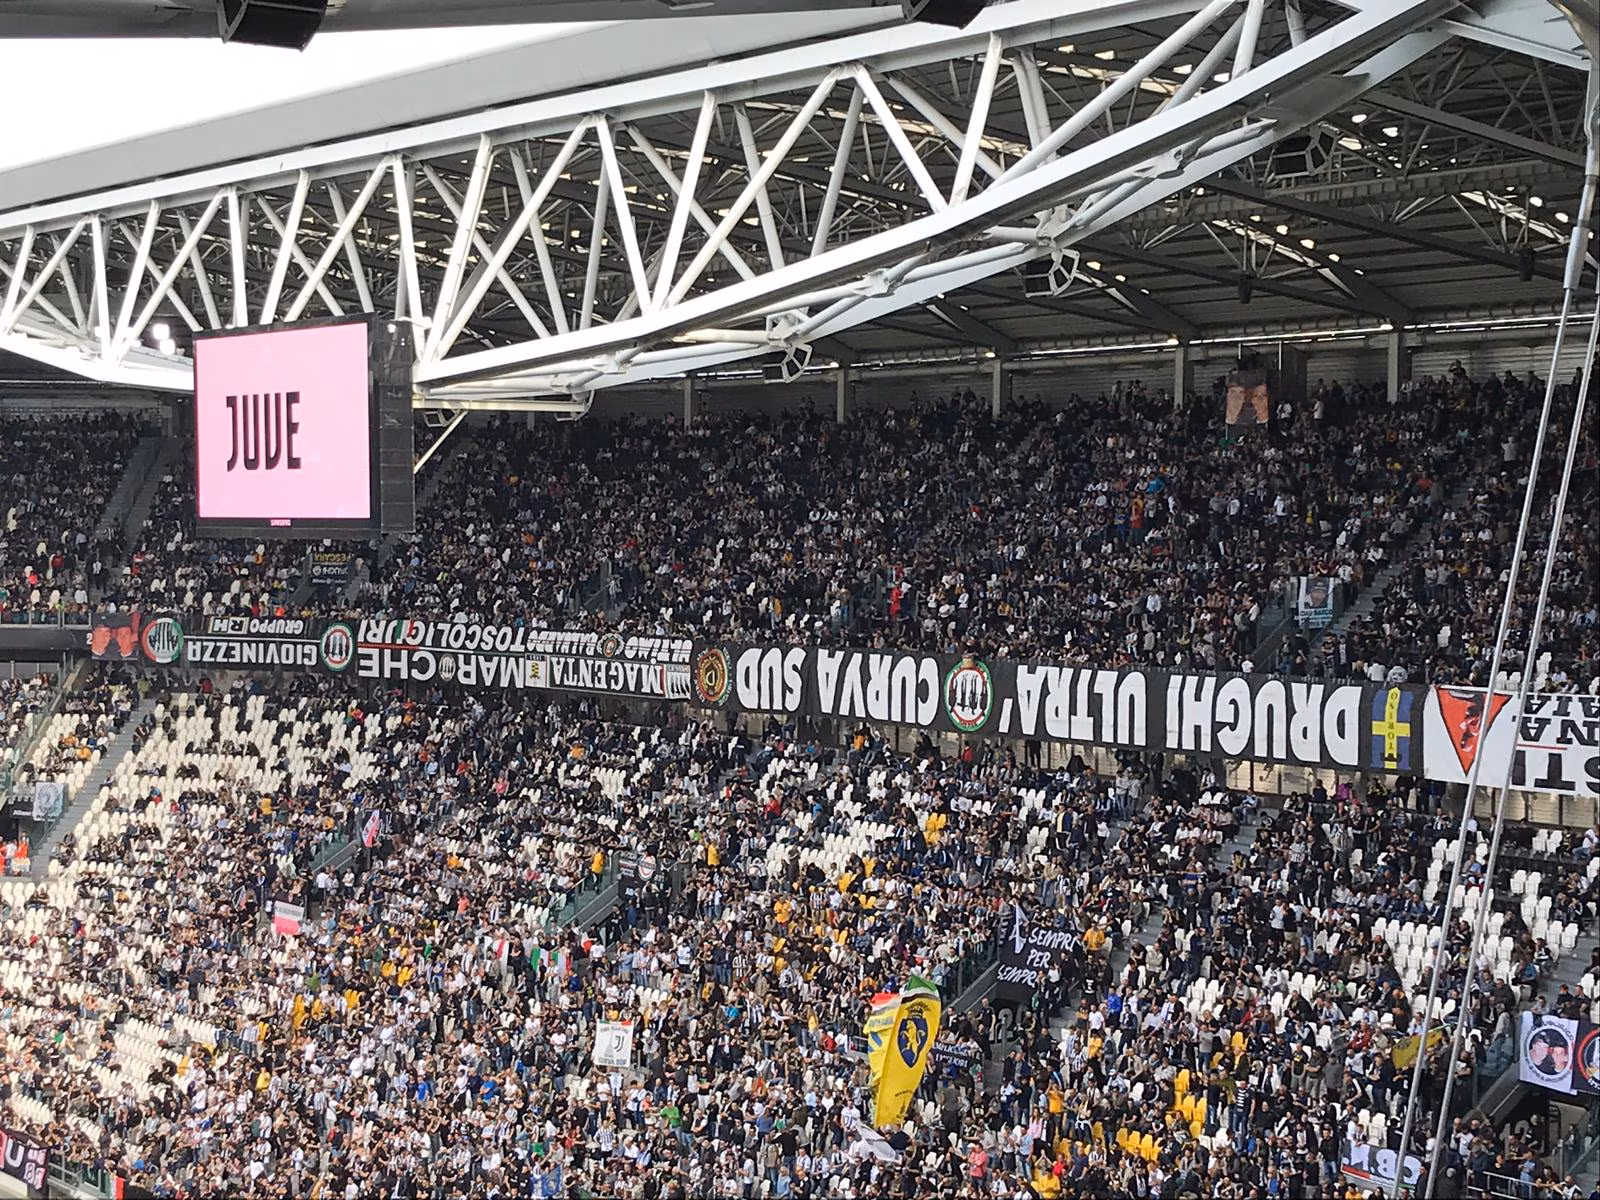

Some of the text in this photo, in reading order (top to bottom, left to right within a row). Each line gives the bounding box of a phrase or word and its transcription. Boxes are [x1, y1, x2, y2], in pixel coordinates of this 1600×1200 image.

[226, 391, 301, 472] JUVE
[250, 618, 304, 635] GRUPPO
[187, 640, 317, 665] GIOVINEZZA
[550, 657, 663, 695] MAGENTA
[736, 647, 806, 712] SUD
[817, 648, 939, 726] CURVA
[999, 665, 1146, 747] ULTRA'
[1165, 674, 1362, 766] DRUGHI
[997, 964, 1037, 988] SEMPR
[1027, 949, 1051, 968] PER
